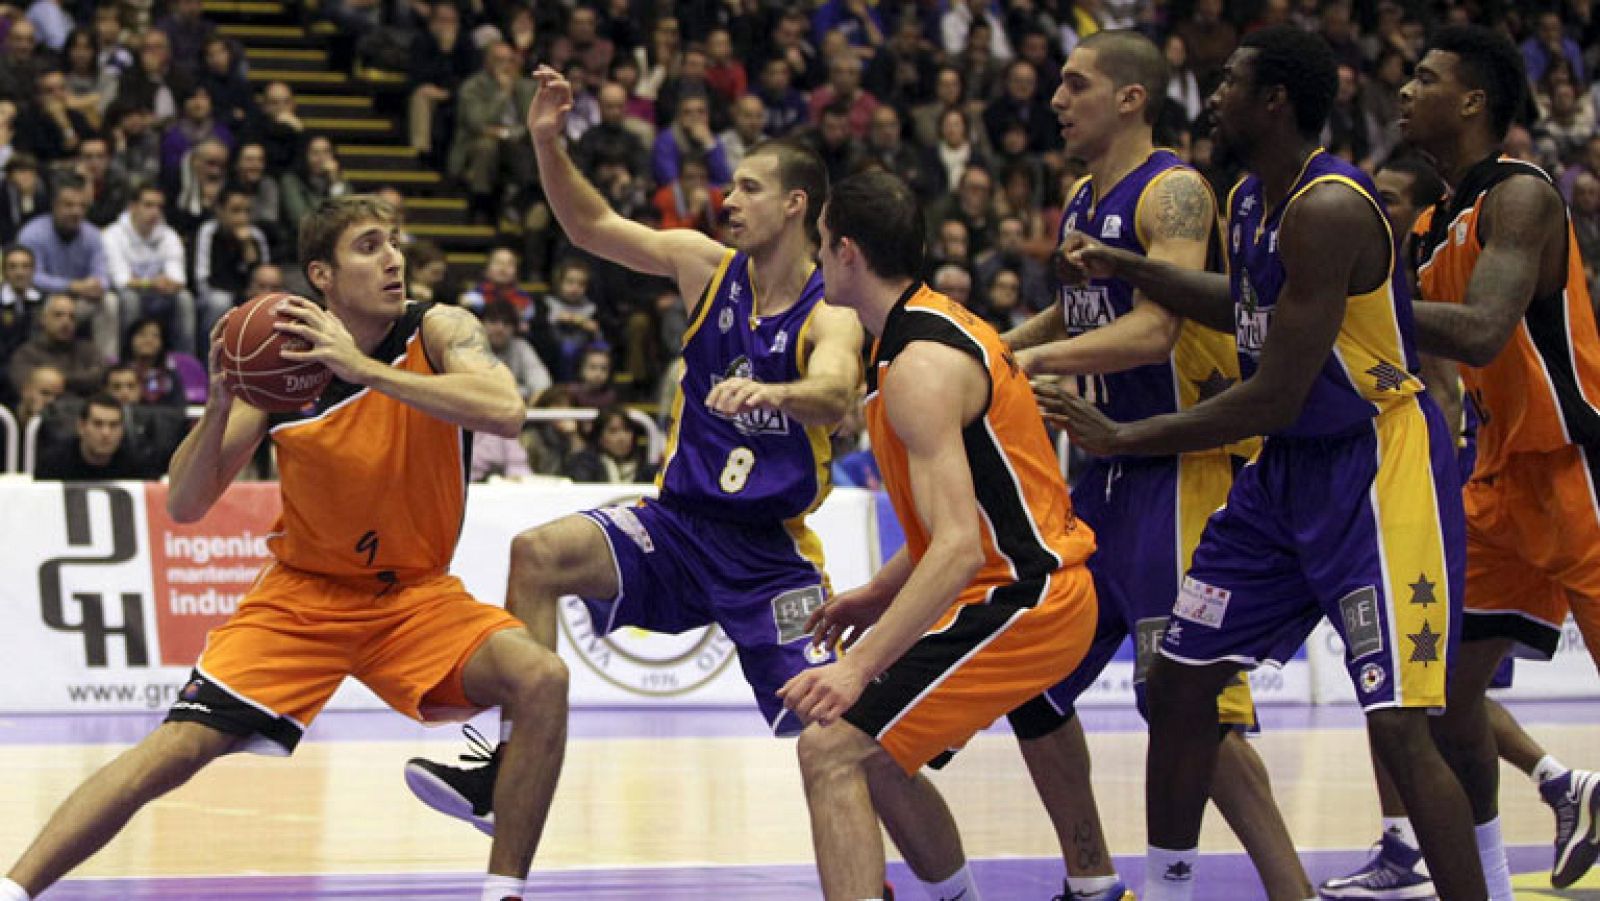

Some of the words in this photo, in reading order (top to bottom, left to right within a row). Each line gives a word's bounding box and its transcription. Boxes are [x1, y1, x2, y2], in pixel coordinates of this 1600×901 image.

[719, 446, 756, 493] 8
[1345, 600, 1372, 633] BE
[66, 682, 179, 709] www.gr
